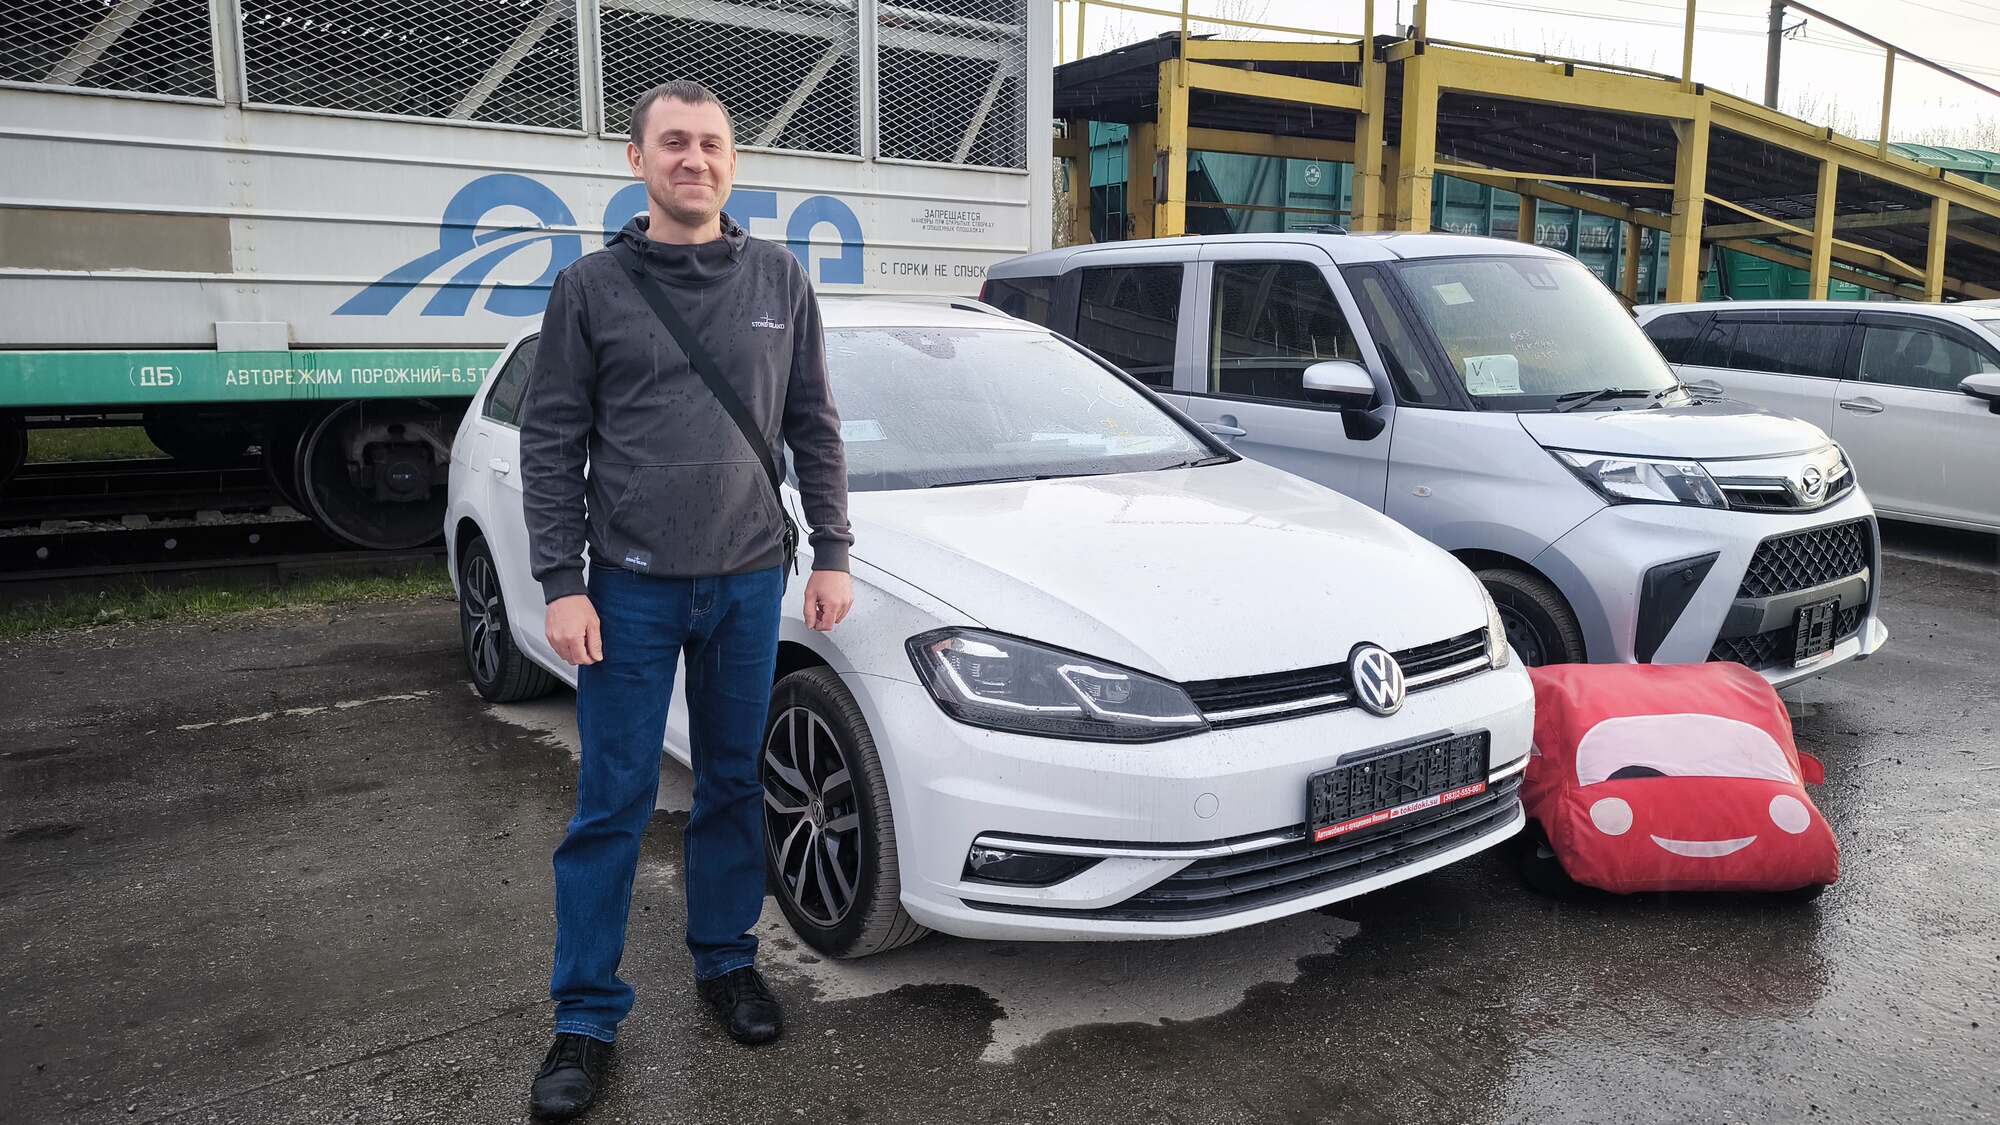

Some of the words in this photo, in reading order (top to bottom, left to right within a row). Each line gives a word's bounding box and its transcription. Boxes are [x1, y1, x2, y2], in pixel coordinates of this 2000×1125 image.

[924, 208, 981, 221] ЗАПРЕЩАЕТСЯ
[880, 262, 887, 275] С
[893, 262, 928, 276] ГОРКИ
[934, 264, 948, 277] НЕ
[129, 366, 183, 387] (ДБ)
[225, 368, 342, 386] АВТОРЕЖИМ
[1400, 799, 1438, 815] tokidoki.su
